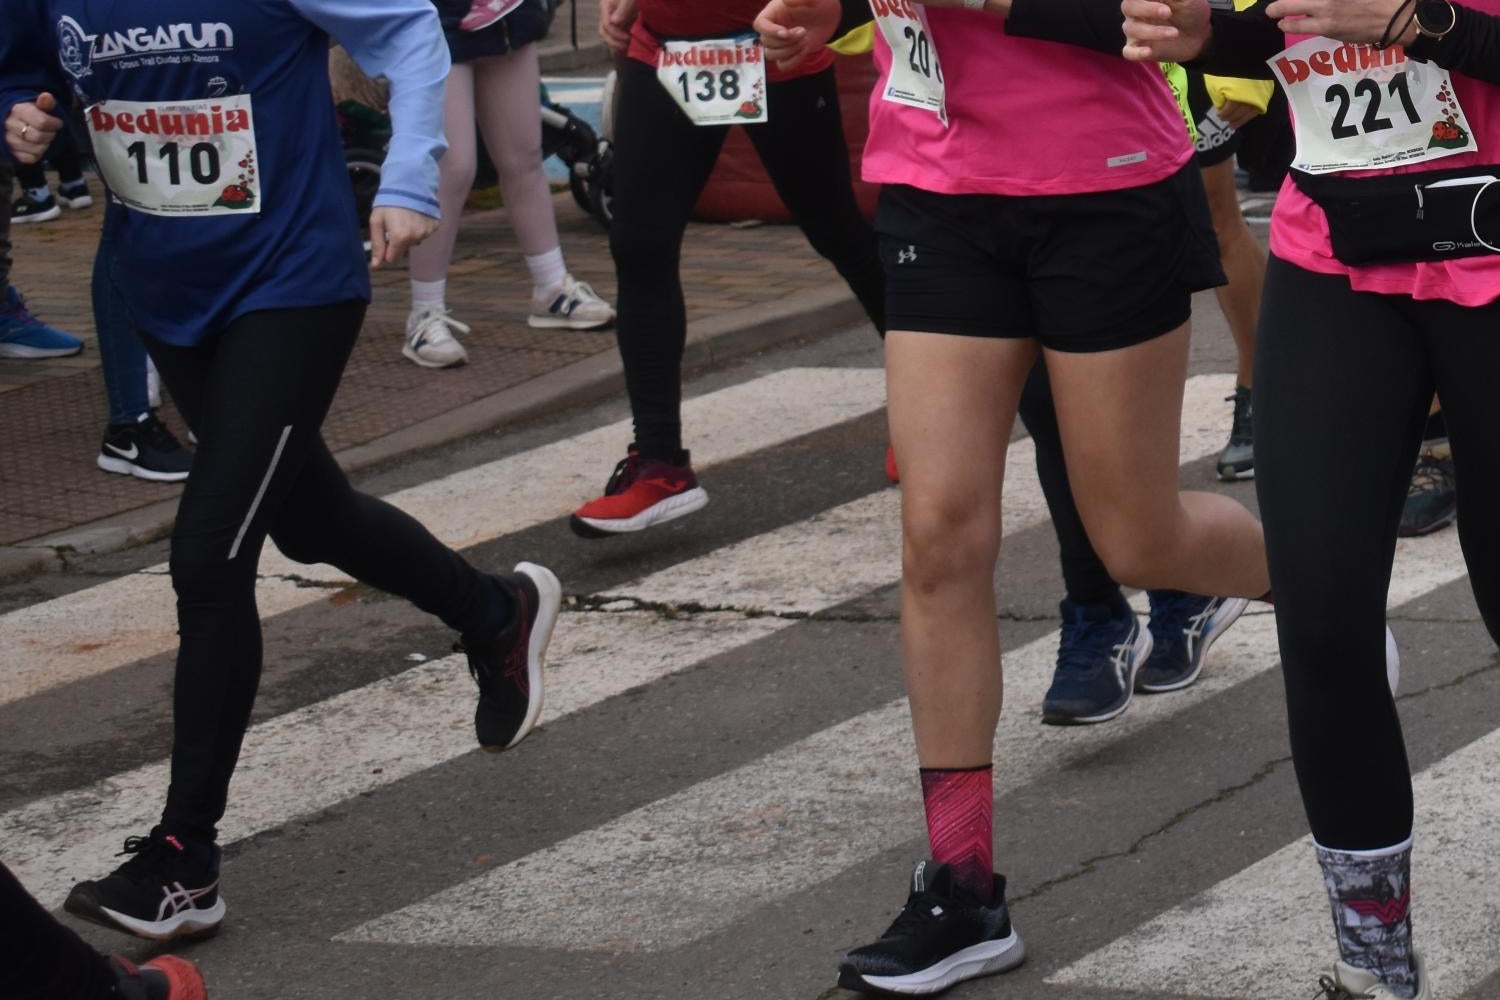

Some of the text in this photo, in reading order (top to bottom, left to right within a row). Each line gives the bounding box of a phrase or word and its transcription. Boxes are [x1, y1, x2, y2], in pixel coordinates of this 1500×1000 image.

[663, 45, 761, 67] bedunia
[1275, 40, 1406, 84] bedun
[678, 70, 740, 103] 138
[1325, 72, 1421, 139] 221
[90, 105, 249, 136] bedunia
[127, 141, 221, 185] 110
